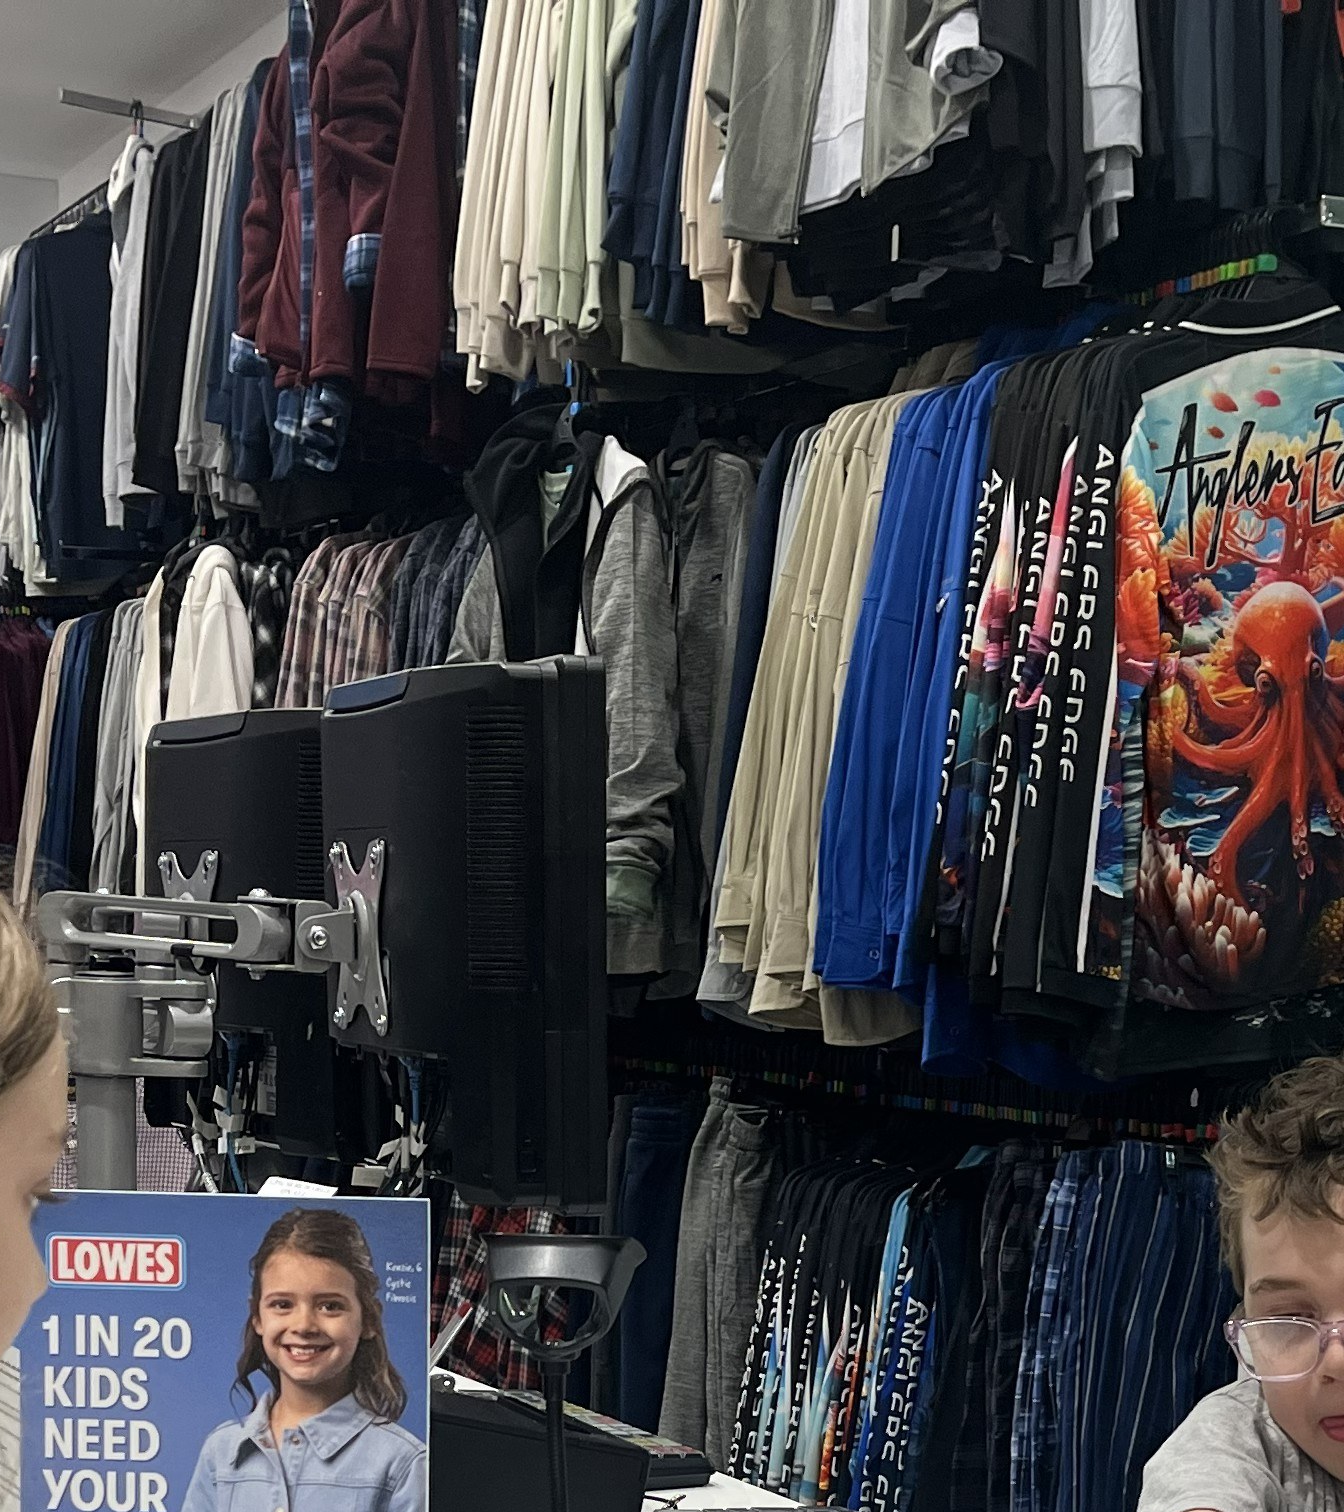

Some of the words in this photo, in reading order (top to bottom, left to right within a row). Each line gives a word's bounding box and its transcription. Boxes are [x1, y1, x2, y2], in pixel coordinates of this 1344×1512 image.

[1154, 403, 1302, 568] Anglers
[57, 1241, 175, 1283] LOWES
[416, 1262, 423, 1272] 6
[42, 1314, 59, 1355] 1
[75, 1314, 119, 1357] IN
[133, 1317, 192, 1359] 20
[44, 1366, 149, 1410] KIDS
[44, 1418, 160, 1461] NEED
